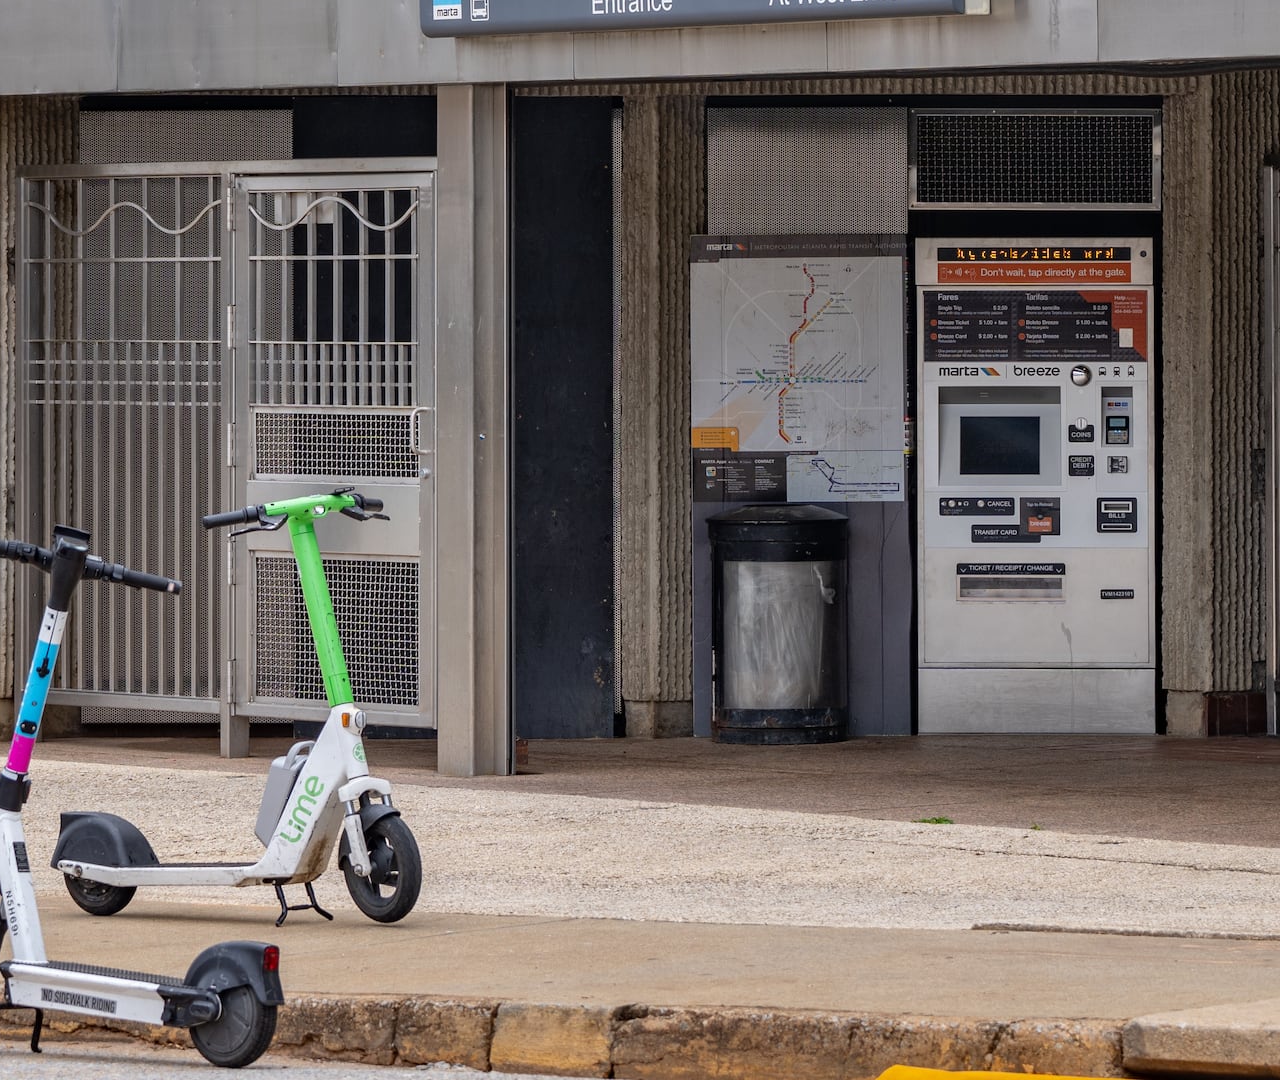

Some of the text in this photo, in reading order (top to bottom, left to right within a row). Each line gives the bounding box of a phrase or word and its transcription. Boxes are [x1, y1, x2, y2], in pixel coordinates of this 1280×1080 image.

[436, 8, 458, 18] marta
[706, 243, 733, 251] marta
[980, 268, 1126, 278] Don't wait, tap directly at the gate.
[937, 293, 959, 301] Fares
[1025, 293, 1048, 301] Tarifas
[939, 365, 1060, 377] marta breeze
[987, 500, 1012, 508] CANCEL
[42, 988, 116, 1014] NO SIDEWALK RIDING
